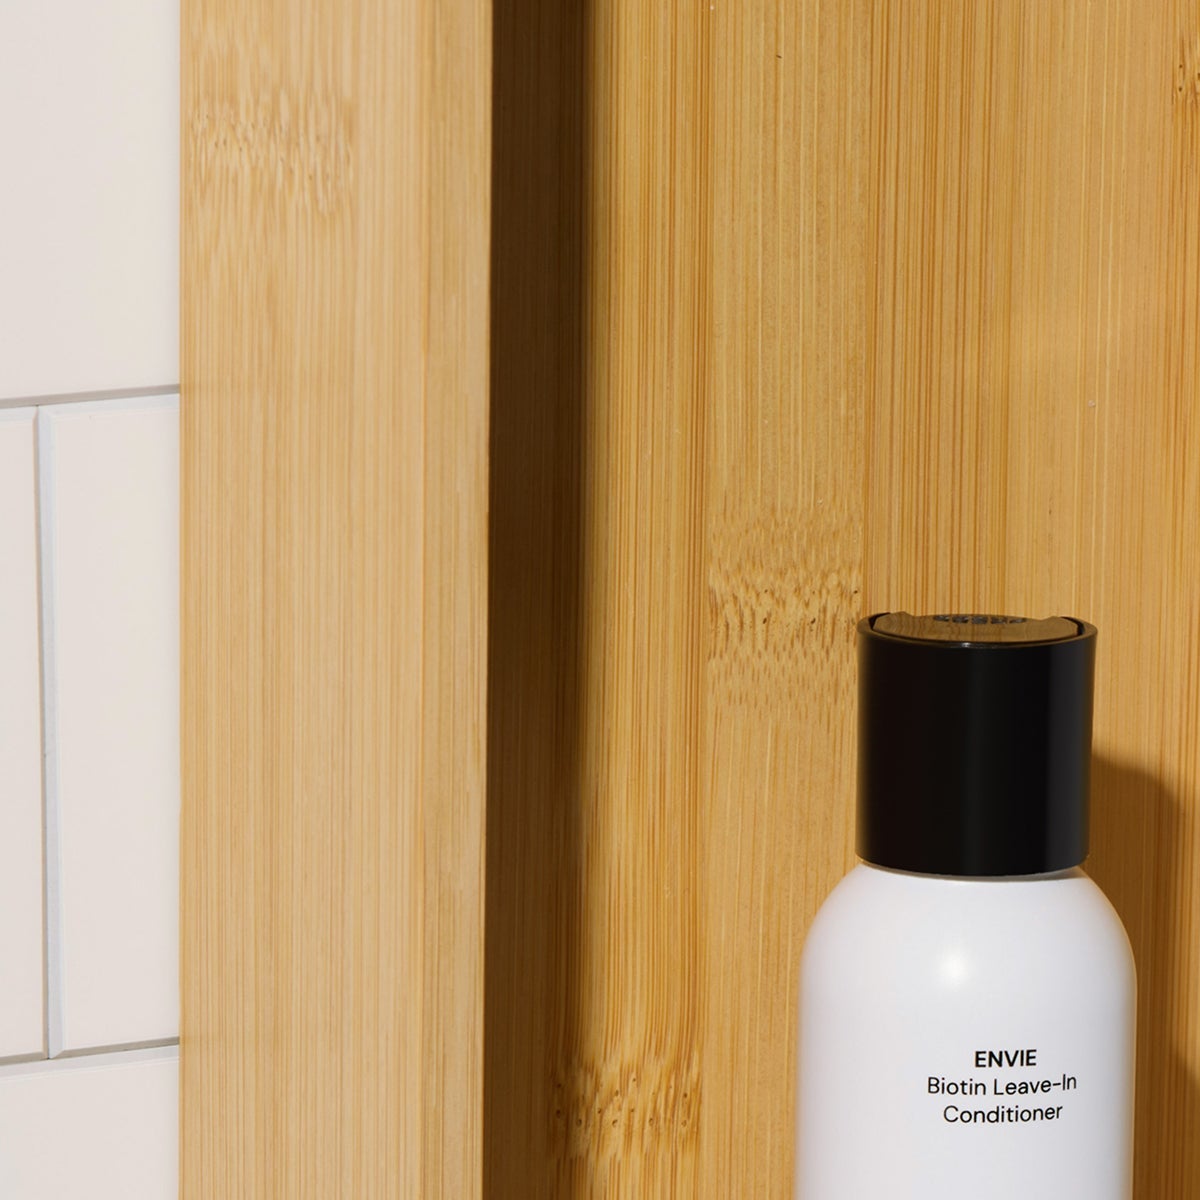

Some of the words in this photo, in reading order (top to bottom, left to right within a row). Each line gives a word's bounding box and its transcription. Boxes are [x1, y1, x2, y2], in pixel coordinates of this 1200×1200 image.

[974, 1048, 1038, 1068] ENVIE
[927, 1076, 987, 1096] Biotin
[993, 1073, 1078, 1096] Leave-In
[943, 1104, 1064, 1124] Conditioner
